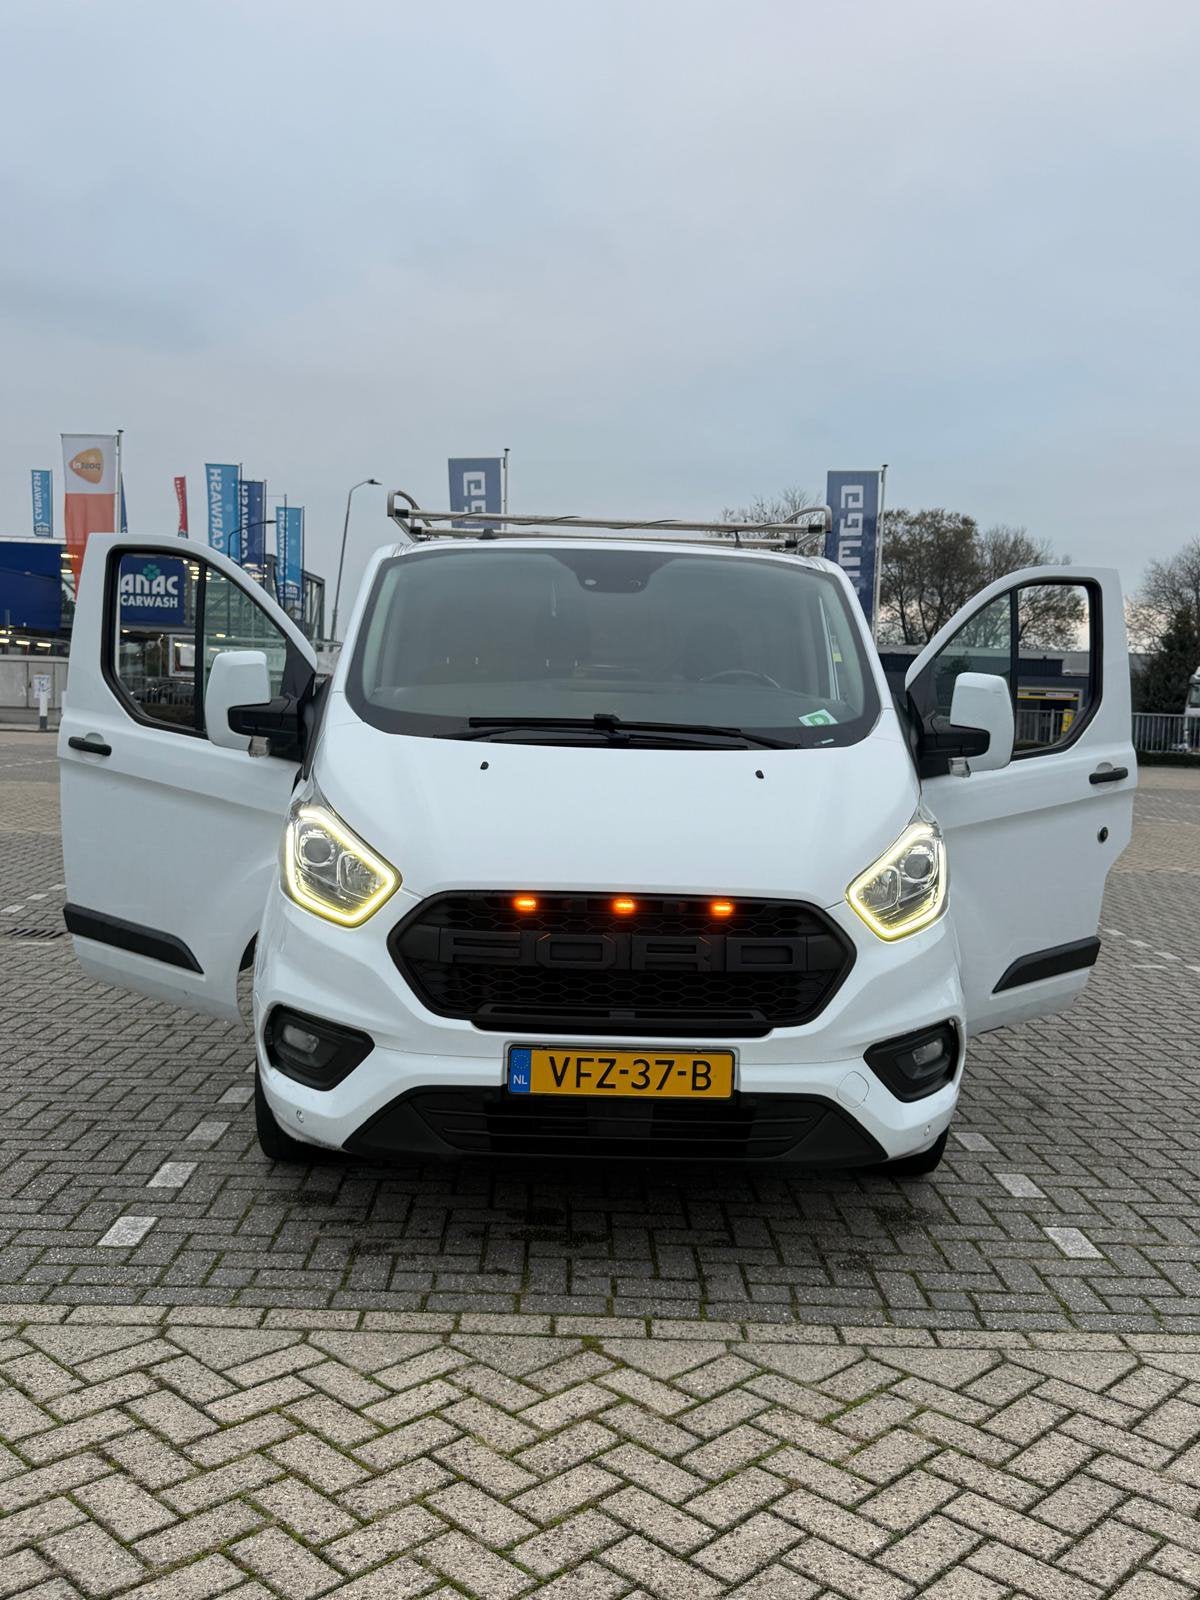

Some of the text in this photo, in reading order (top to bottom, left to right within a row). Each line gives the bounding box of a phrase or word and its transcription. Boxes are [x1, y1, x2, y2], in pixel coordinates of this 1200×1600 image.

[120, 573, 179, 596] ANAC
[120, 594, 179, 609] CARWASH
[439, 928, 807, 973] FORD
[513, 1074, 528, 1086] NL
[548, 1055, 712, 1092] VFZ-37-B
